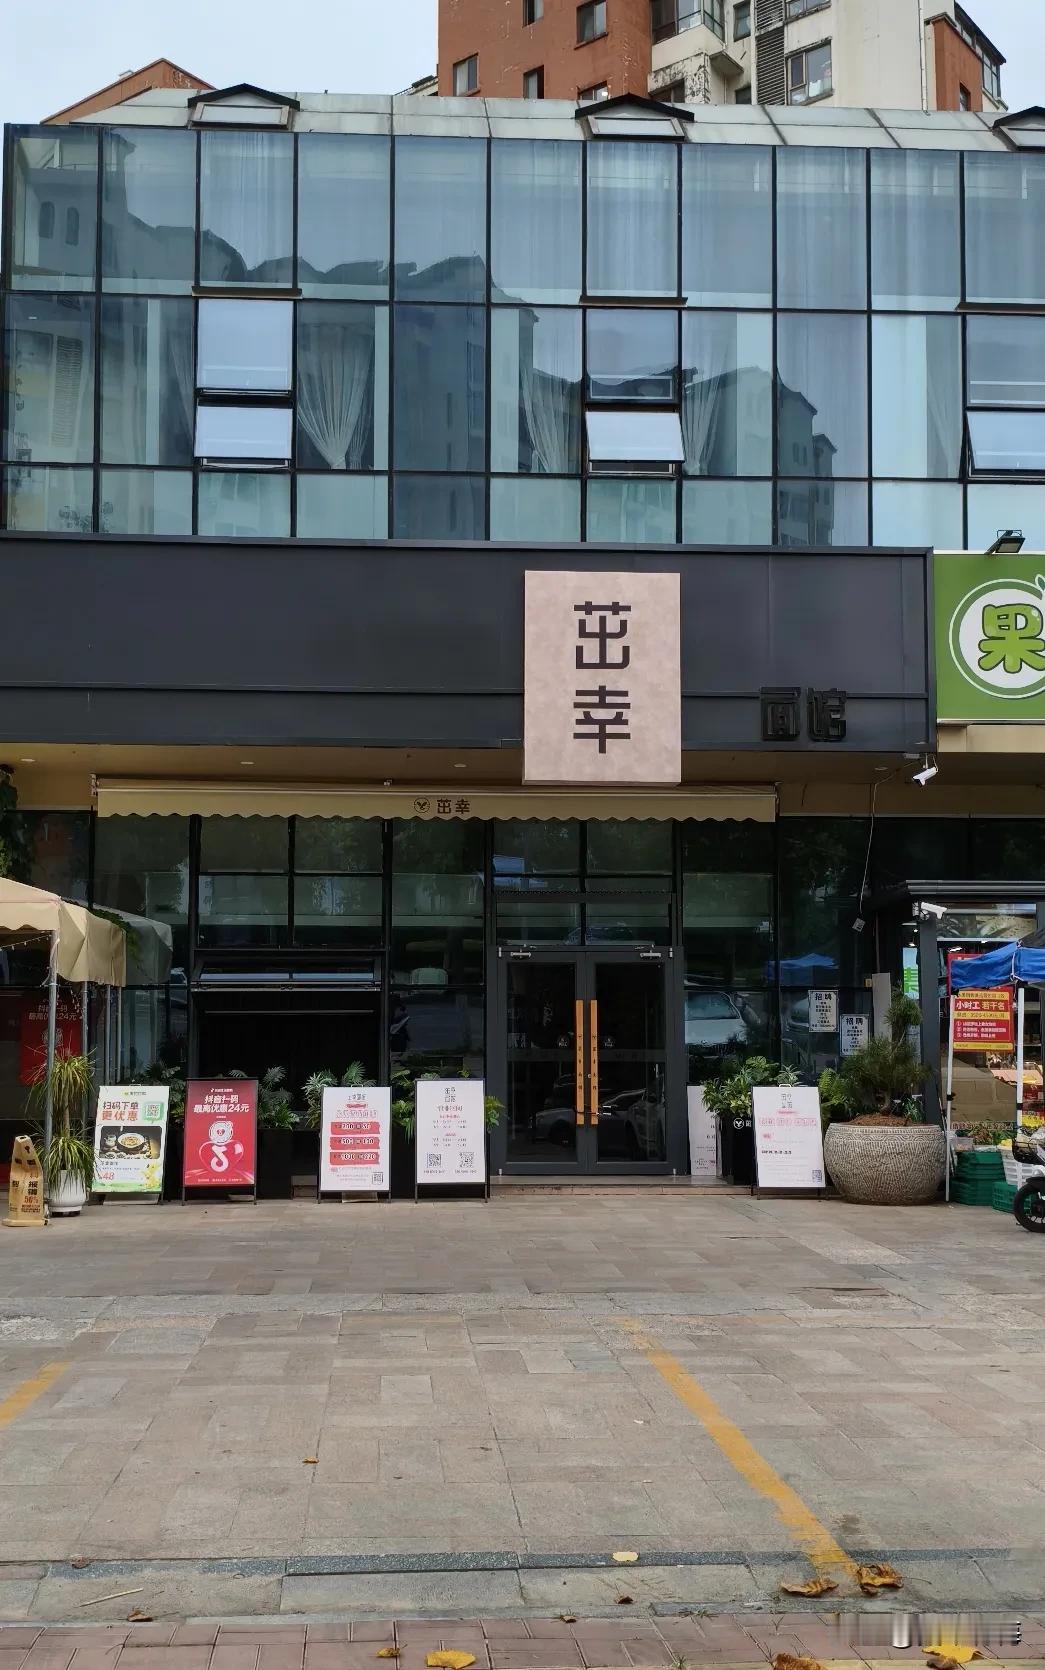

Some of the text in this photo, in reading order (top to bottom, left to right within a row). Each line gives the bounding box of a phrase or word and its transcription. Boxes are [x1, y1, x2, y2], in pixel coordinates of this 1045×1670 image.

[978, 603, 1045, 674] 果
[573, 601, 631, 754] 茁幸
[437, 799, 471, 814] 茁幸
[956, 1001, 1005, 1011] 小时工 若干名
[103, 1101, 139, 1110] 扫码下单
[102, 1110, 138, 1120] 更优惠
